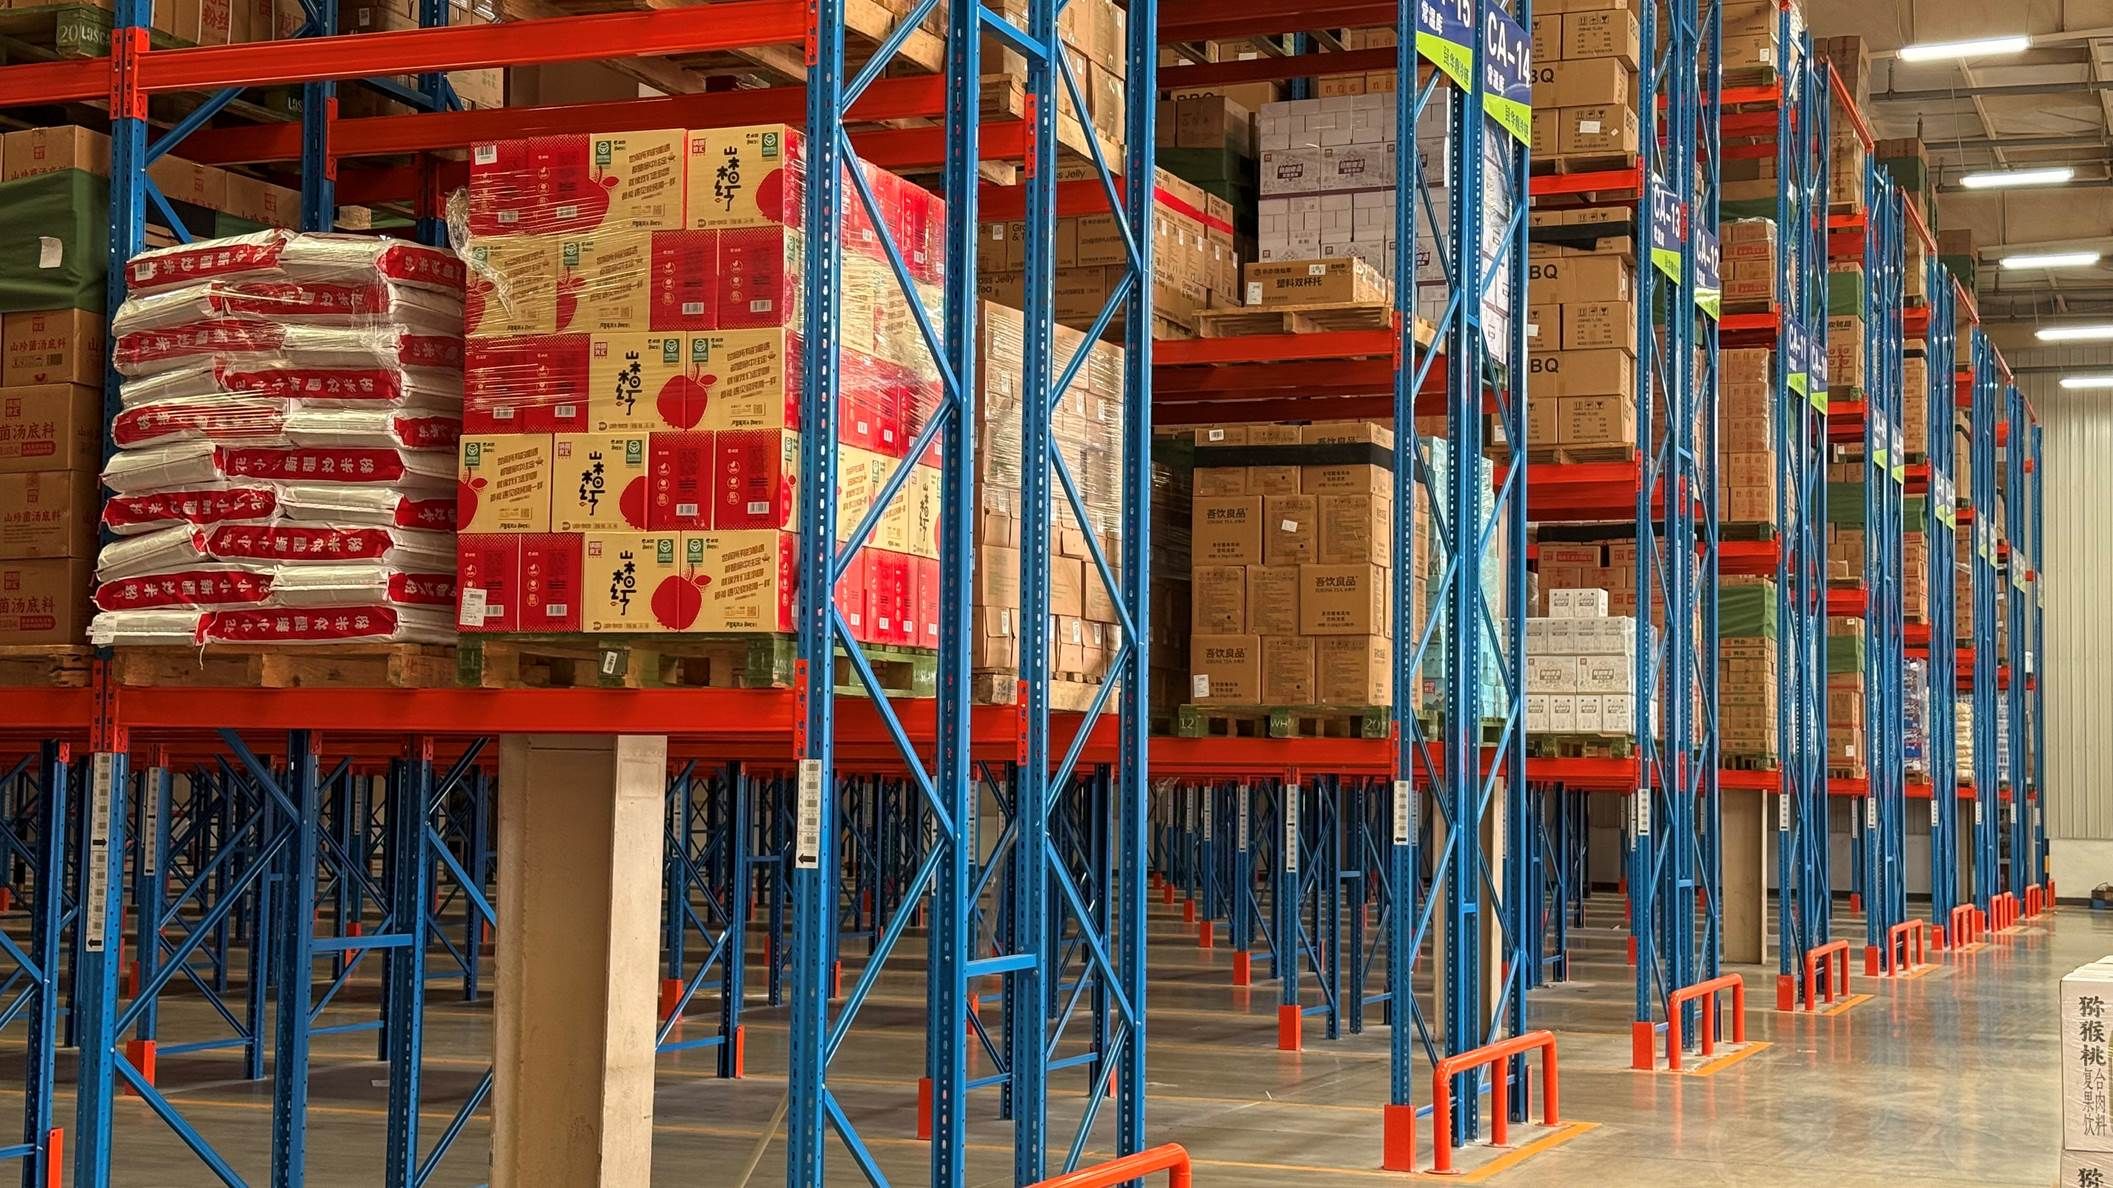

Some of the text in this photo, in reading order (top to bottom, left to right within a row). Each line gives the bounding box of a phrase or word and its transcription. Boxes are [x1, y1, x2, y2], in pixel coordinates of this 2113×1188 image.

[1487, 11, 1531, 88] CA-14
[1653, 184, 1681, 239] CA-13
[1697, 229, 1719, 279] CA-12
[610, 550, 637, 616] 山楂红了
[2078, 995, 2107, 1066] 猕猴桃
